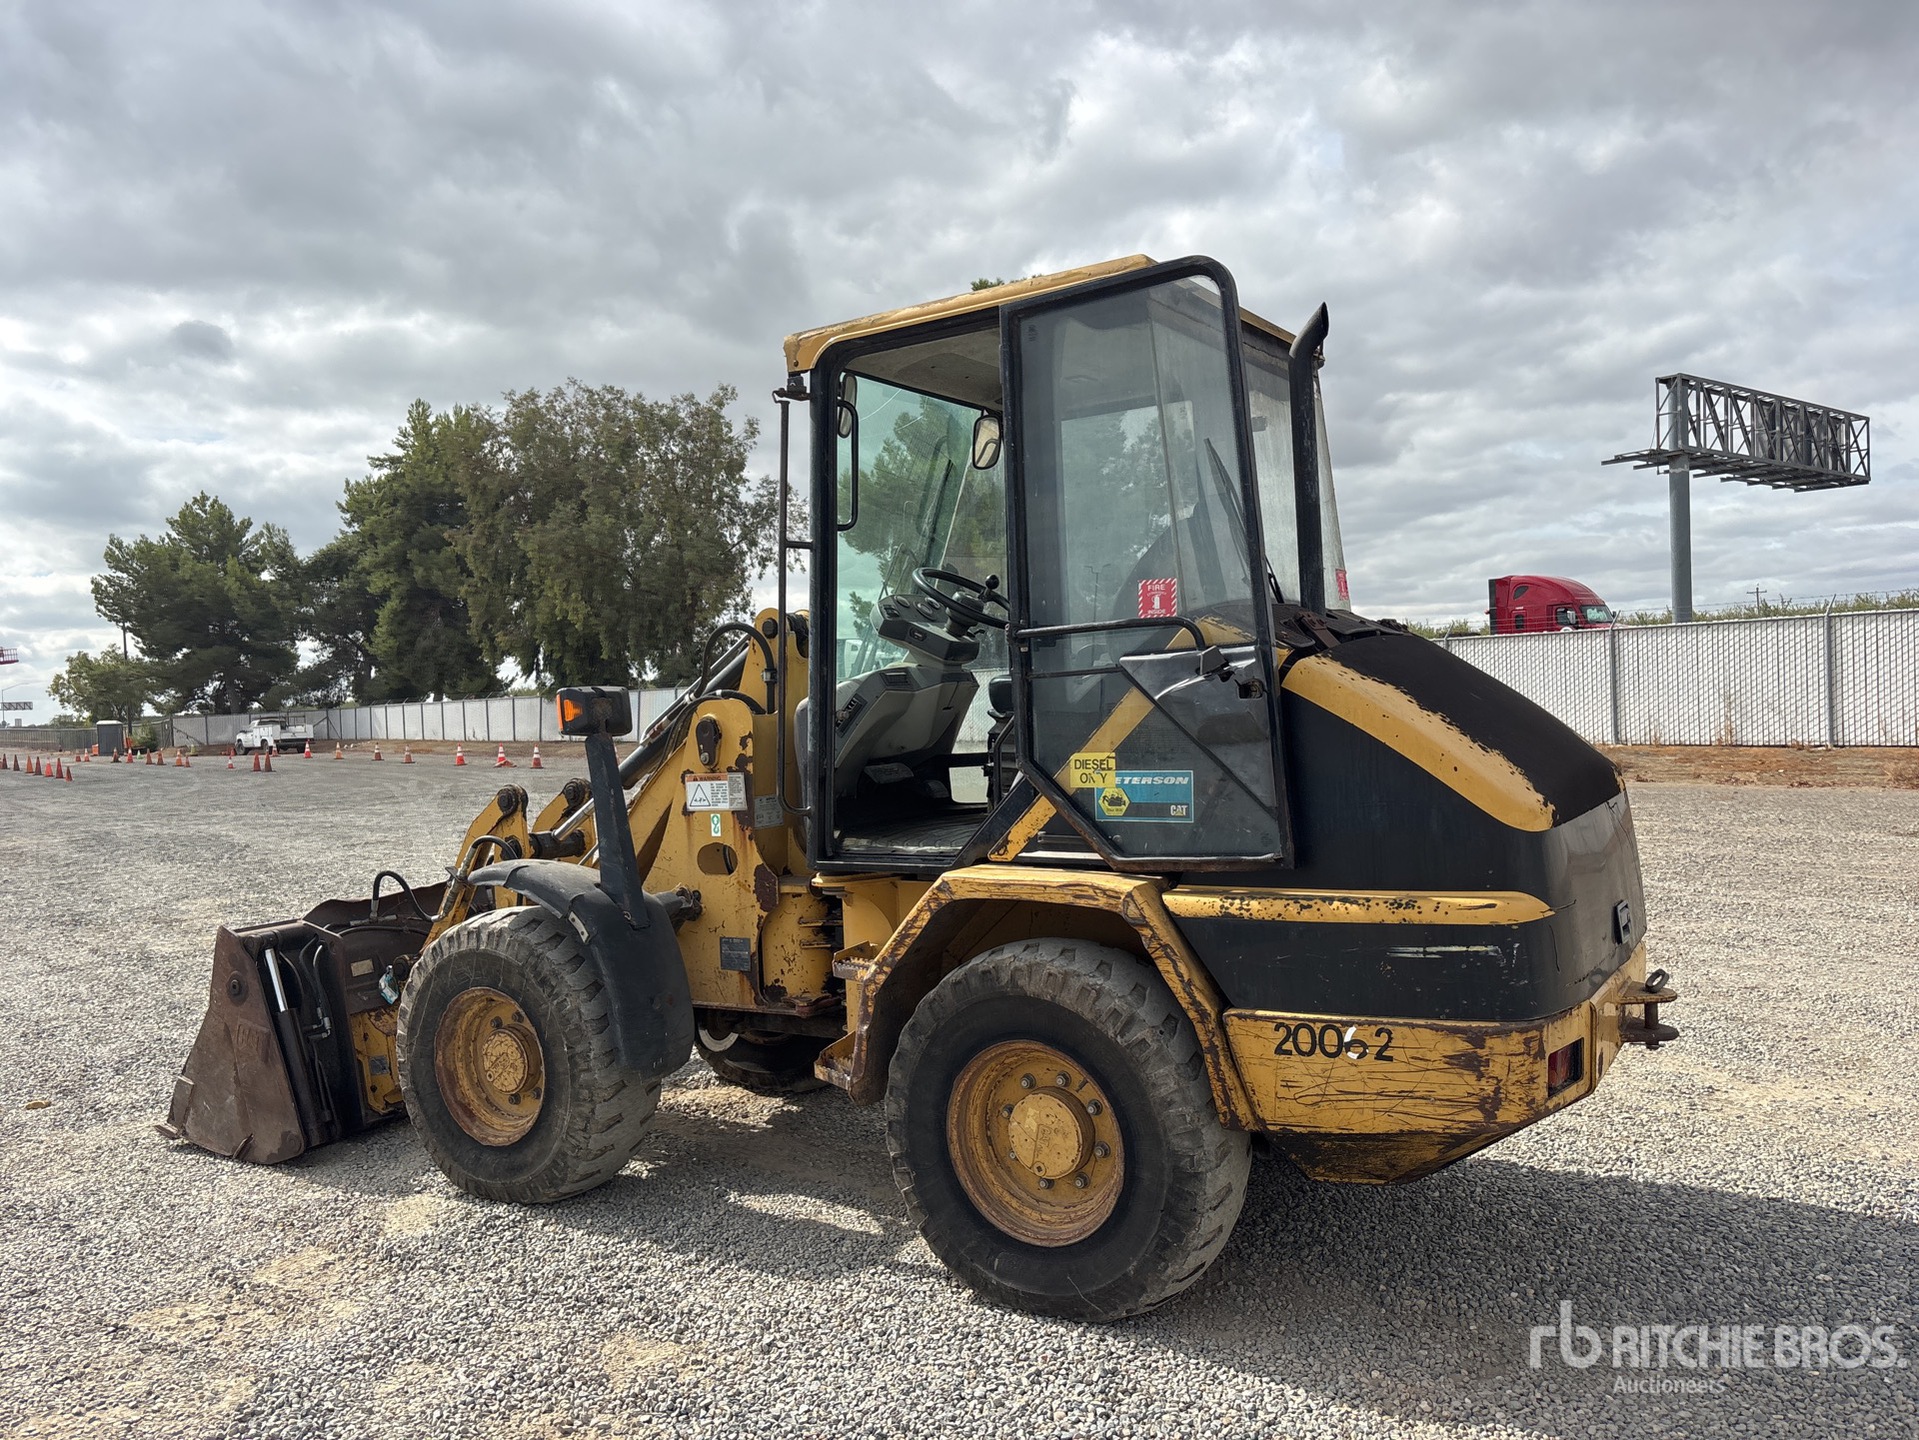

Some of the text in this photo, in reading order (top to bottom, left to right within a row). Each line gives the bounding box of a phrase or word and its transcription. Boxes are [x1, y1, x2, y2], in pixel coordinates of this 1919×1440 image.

[1074, 759, 1113, 770] DIESEL
[1080, 772, 1108, 784] ONY
[1115, 776, 1190, 785] ETERSON
[1170, 804, 1189, 816] CAT
[1274, 1022, 1394, 1062] 20062
